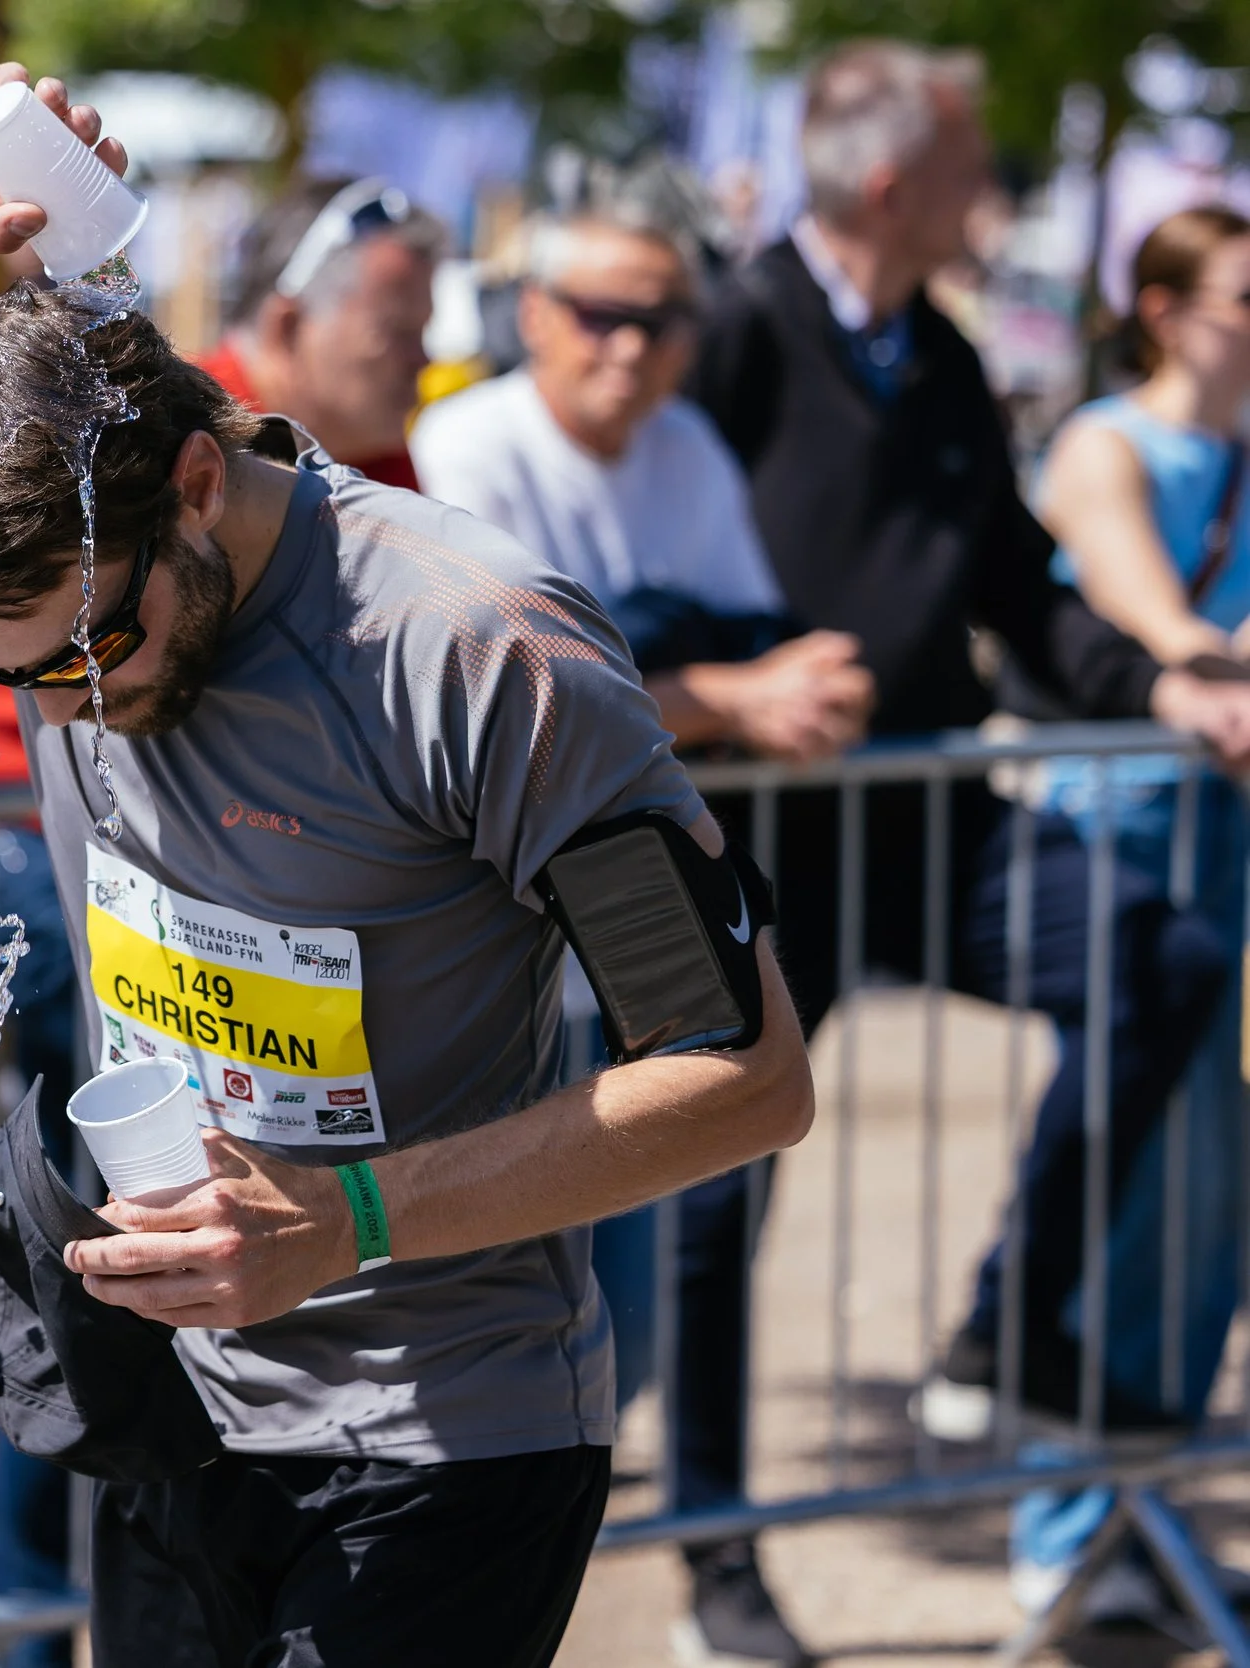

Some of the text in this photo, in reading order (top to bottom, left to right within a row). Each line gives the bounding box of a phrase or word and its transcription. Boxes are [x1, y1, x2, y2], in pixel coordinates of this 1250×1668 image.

[246, 809, 302, 836] asics
[170, 928, 263, 963] SJÆLLAND-FYN
[171, 914, 258, 948] SPAREKASSEN
[172, 963, 234, 1008] 149
[319, 966, 346, 980] 2000
[114, 975, 318, 1070] CHRISTIAN
[273, 1094, 306, 1104] PRO
[364, 1210, 380, 1242] 2024
